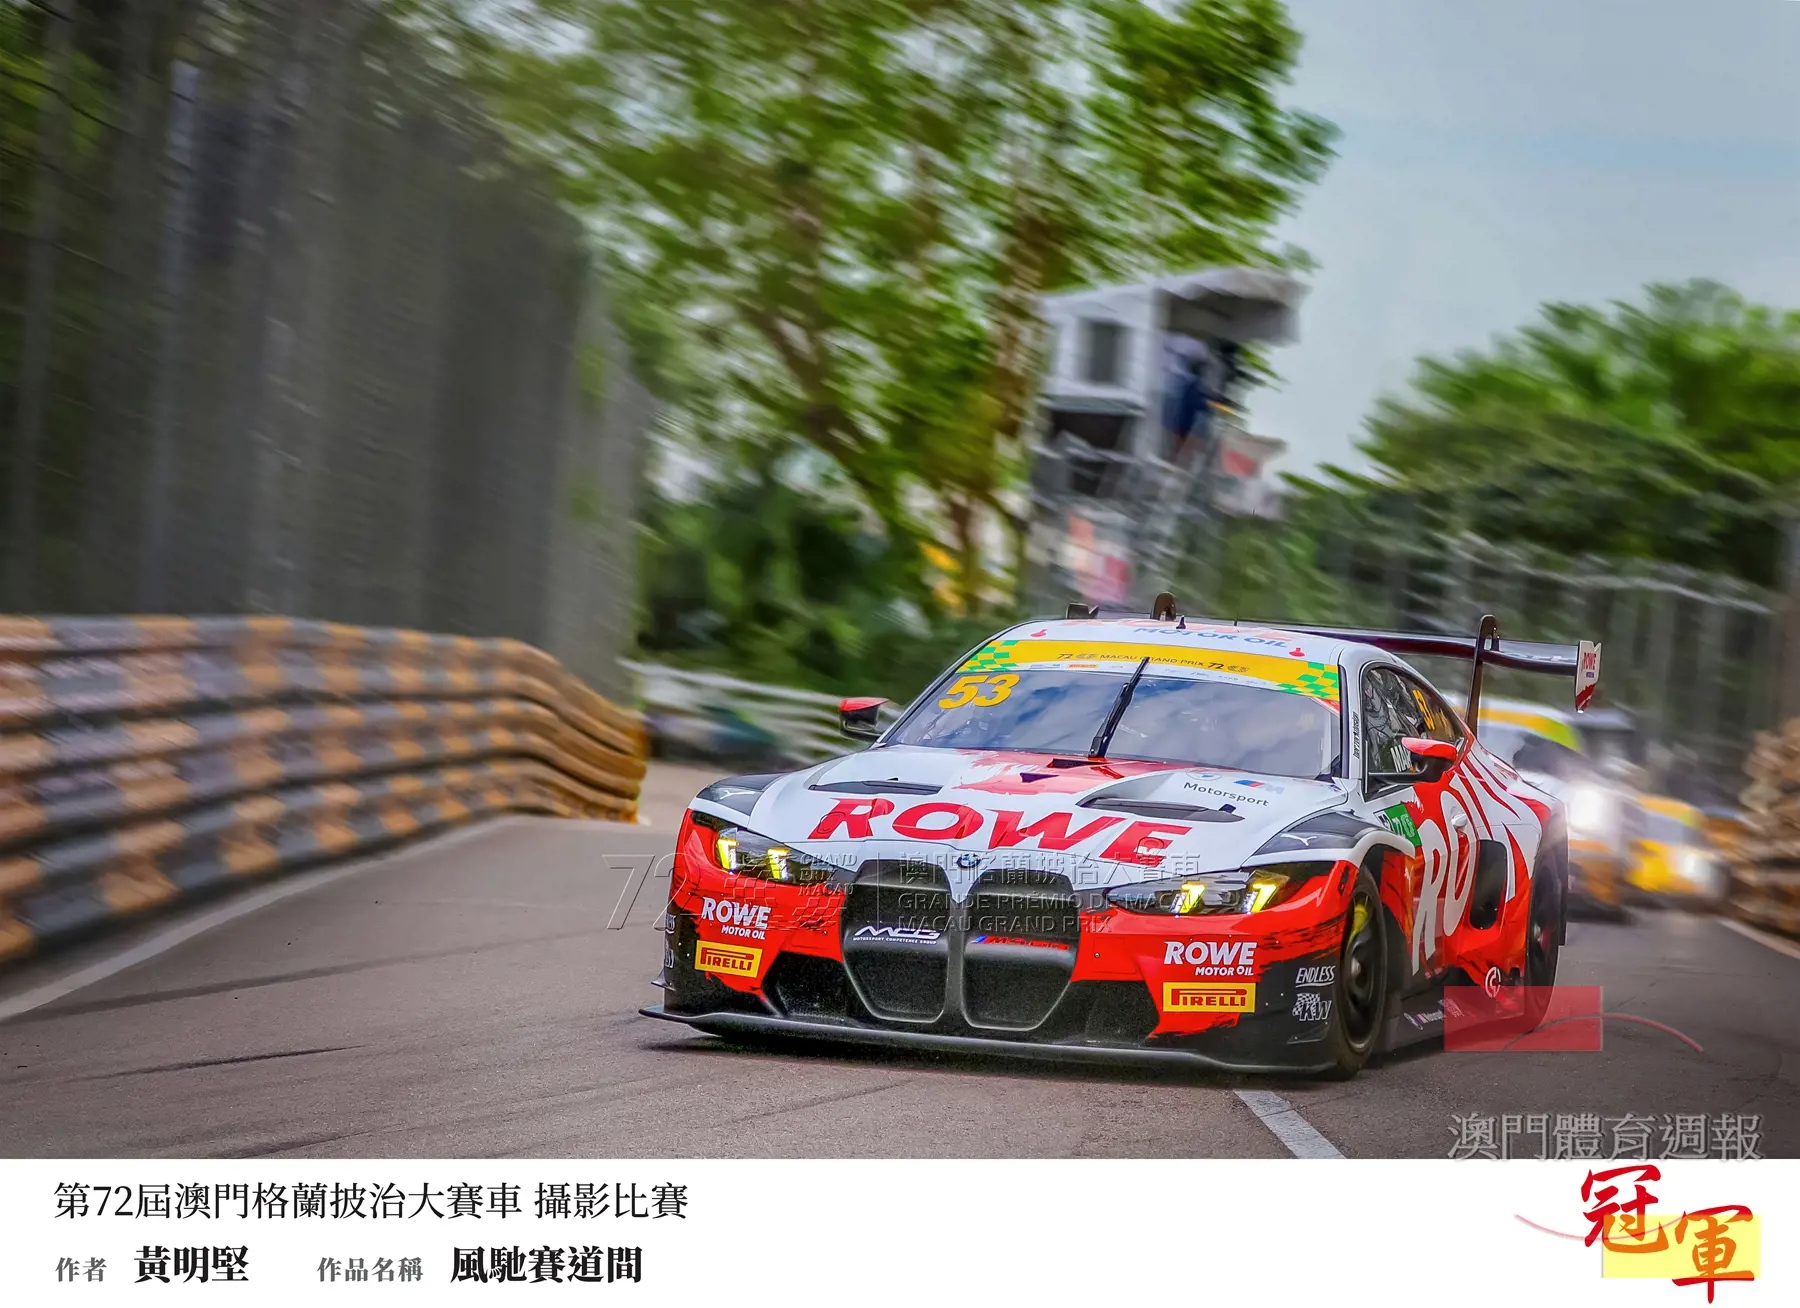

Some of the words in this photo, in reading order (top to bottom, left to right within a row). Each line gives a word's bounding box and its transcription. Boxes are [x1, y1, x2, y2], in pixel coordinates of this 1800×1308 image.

[1133, 627, 1238, 640] MOTOR
[1243, 637, 1288, 648] OIL
[1100, 653, 1138, 661] MACAU
[1180, 659, 1205, 667] PRIX
[1207, 661, 1225, 670] 72
[938, 673, 1020, 709] 53
[1183, 781, 1270, 807] Motorsport
[806, 797, 1193, 868] ROWE
[702, 896, 772, 930] ROWE
[721, 924, 751, 938] MOTOR
[751, 930, 766, 940] OIL
[699, 946, 755, 972] PIRELLI
[1163, 941, 1258, 965] ROWE
[1194, 966, 1235, 976] MOTOR
[1236, 965, 1255, 976] OIL
[1294, 965, 1337, 986] ENDLESS
[1170, 988, 1248, 1007] PIRELLI
[1299, 998, 1332, 1022] KW
